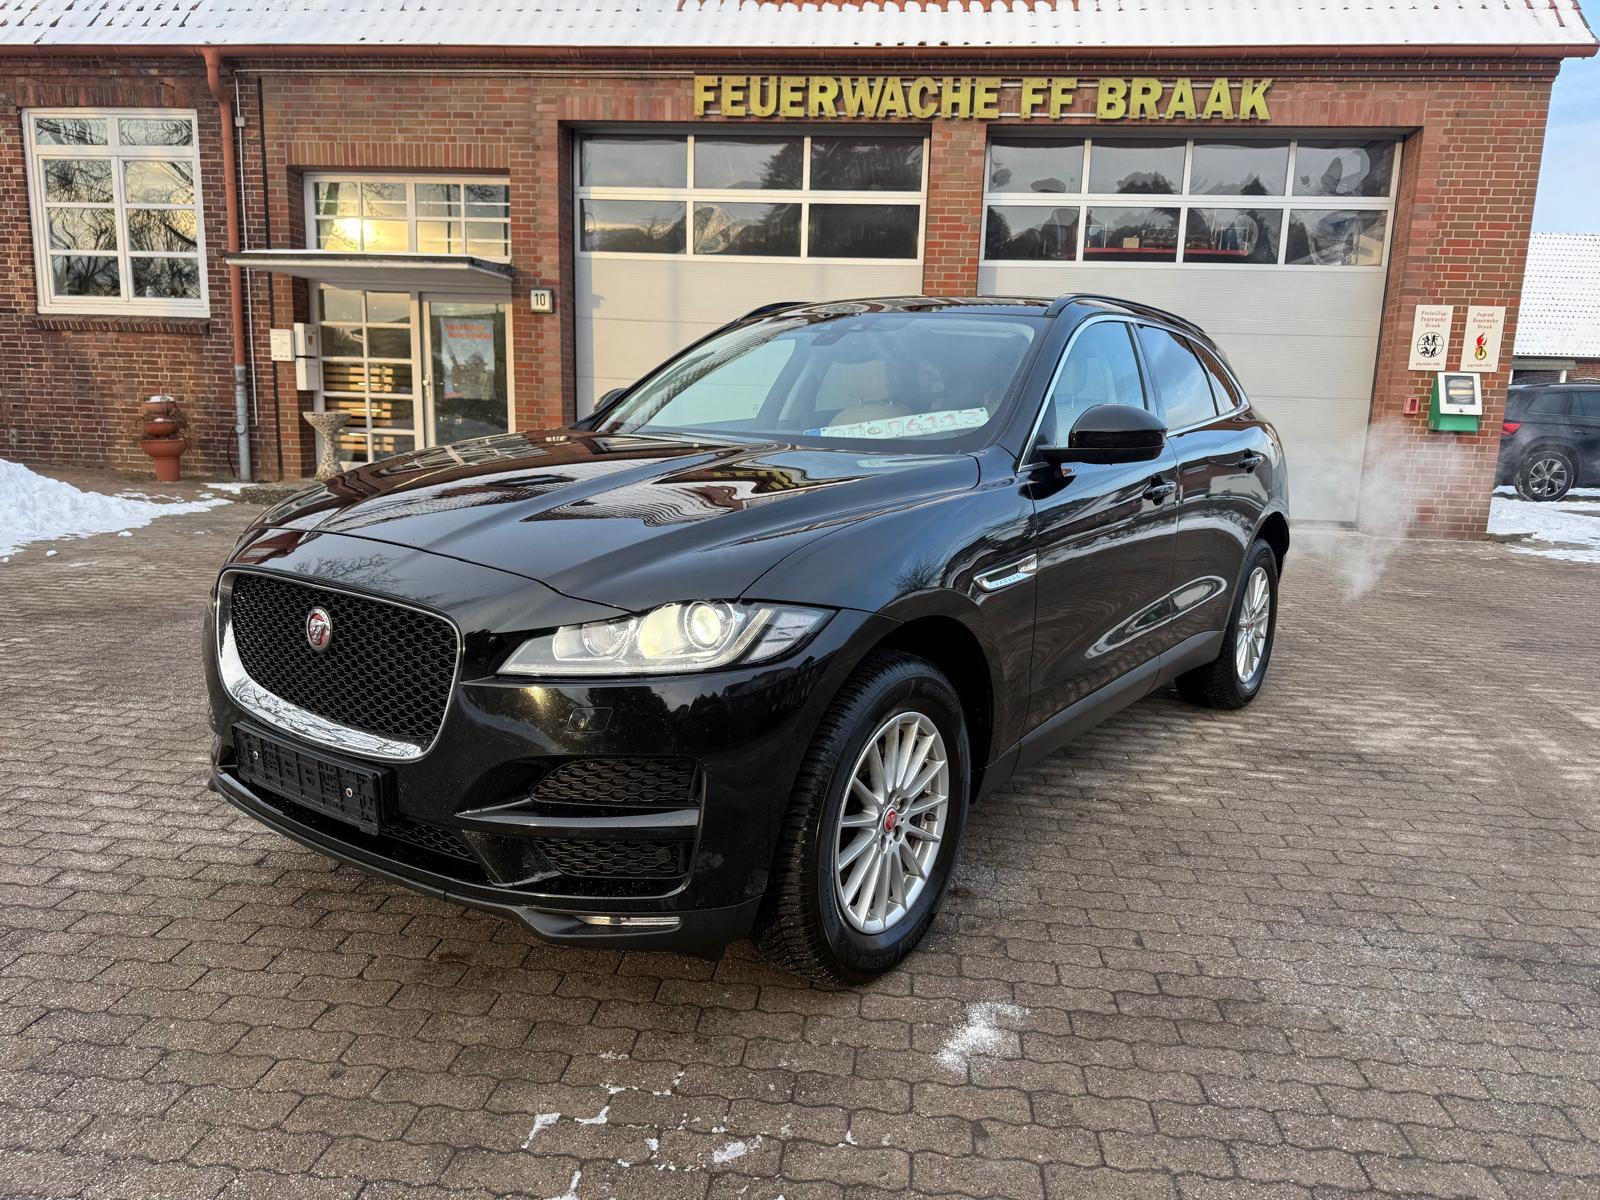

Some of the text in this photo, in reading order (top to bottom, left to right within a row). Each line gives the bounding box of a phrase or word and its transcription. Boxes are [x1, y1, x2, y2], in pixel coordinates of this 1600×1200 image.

[694, 75, 1273, 120] FEUERWACHE FF BRAAK
[534, 293, 546, 307] 10
